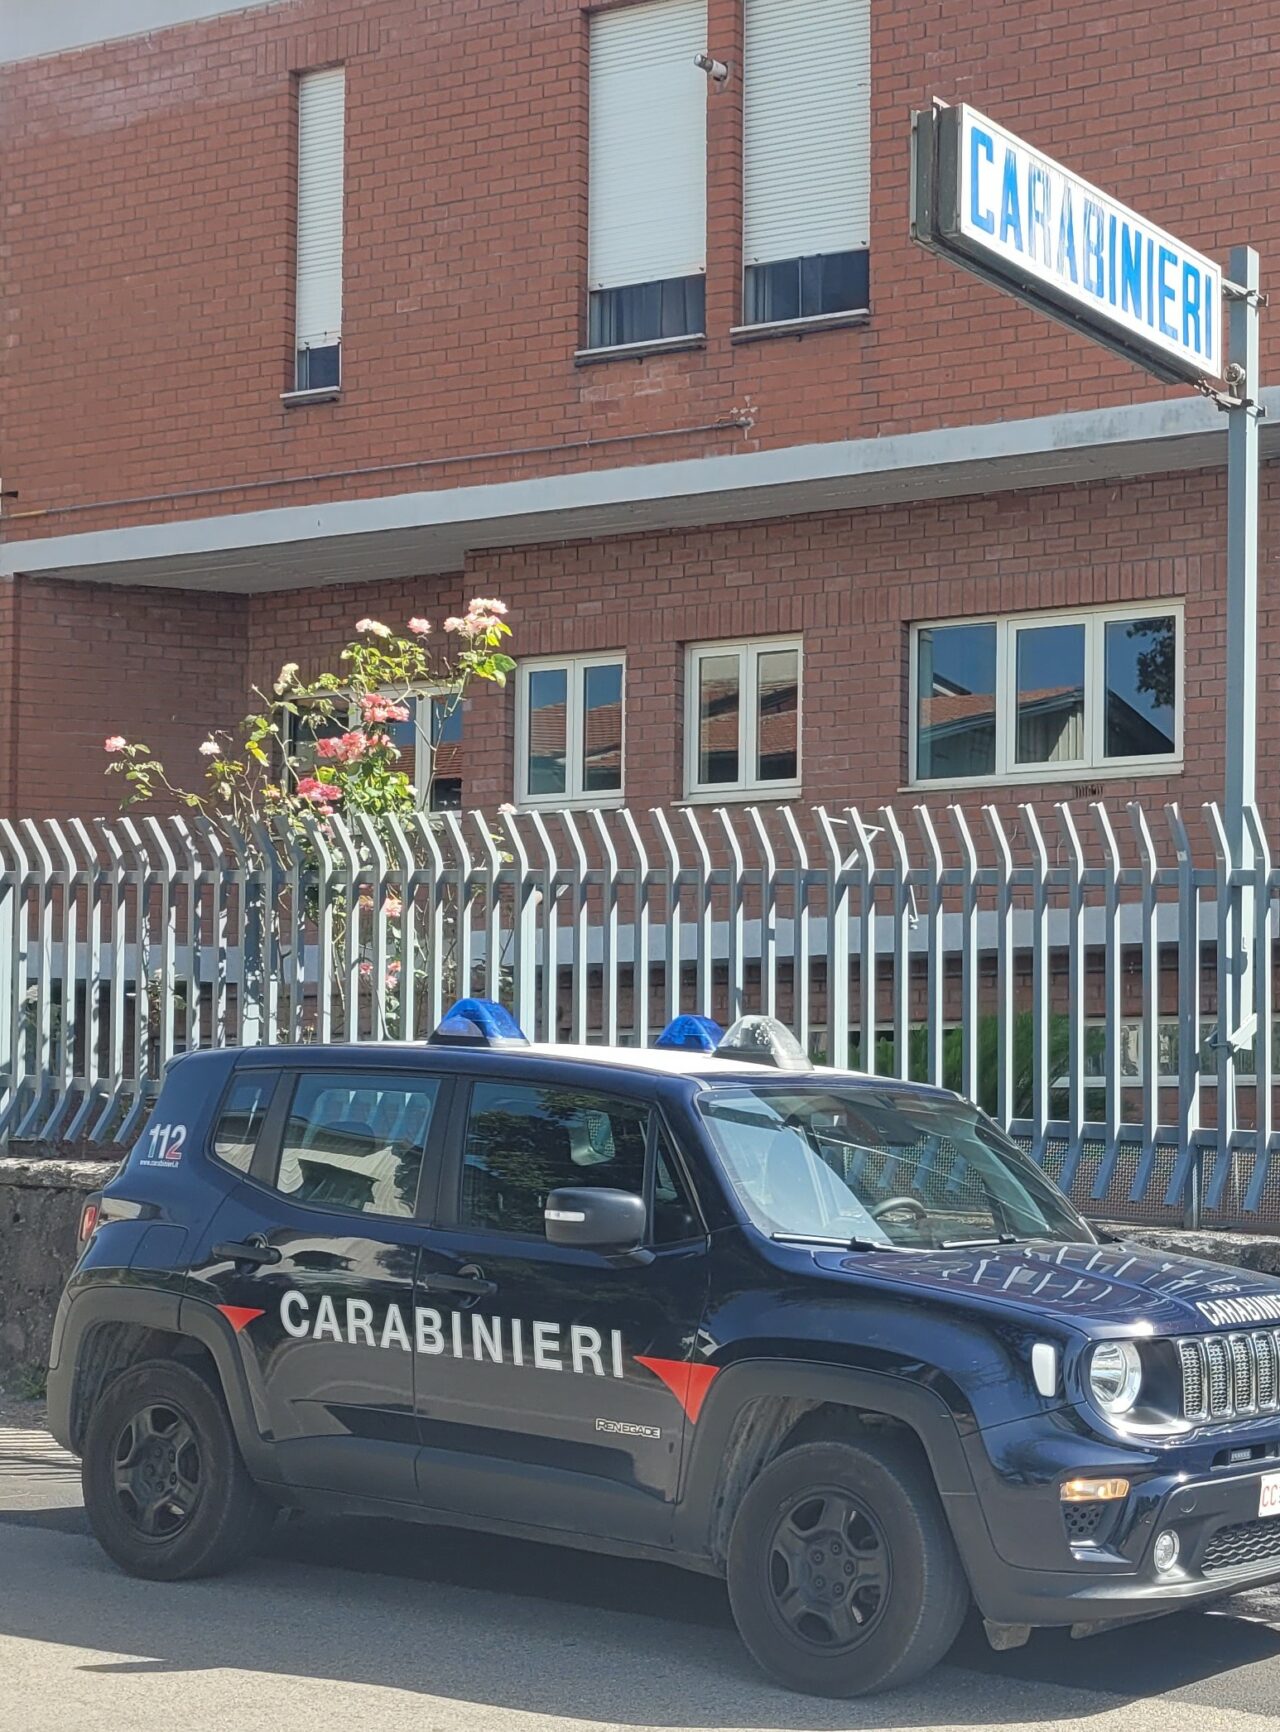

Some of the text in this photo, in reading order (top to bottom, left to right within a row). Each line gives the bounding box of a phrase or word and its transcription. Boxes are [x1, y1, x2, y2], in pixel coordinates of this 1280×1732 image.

[970, 126, 1213, 361] CARABINIERI
[148, 1123, 187, 1160] 112
[279, 1290, 624, 1378] CARABINIERI
[595, 1417, 661, 1439] RENEGADE
